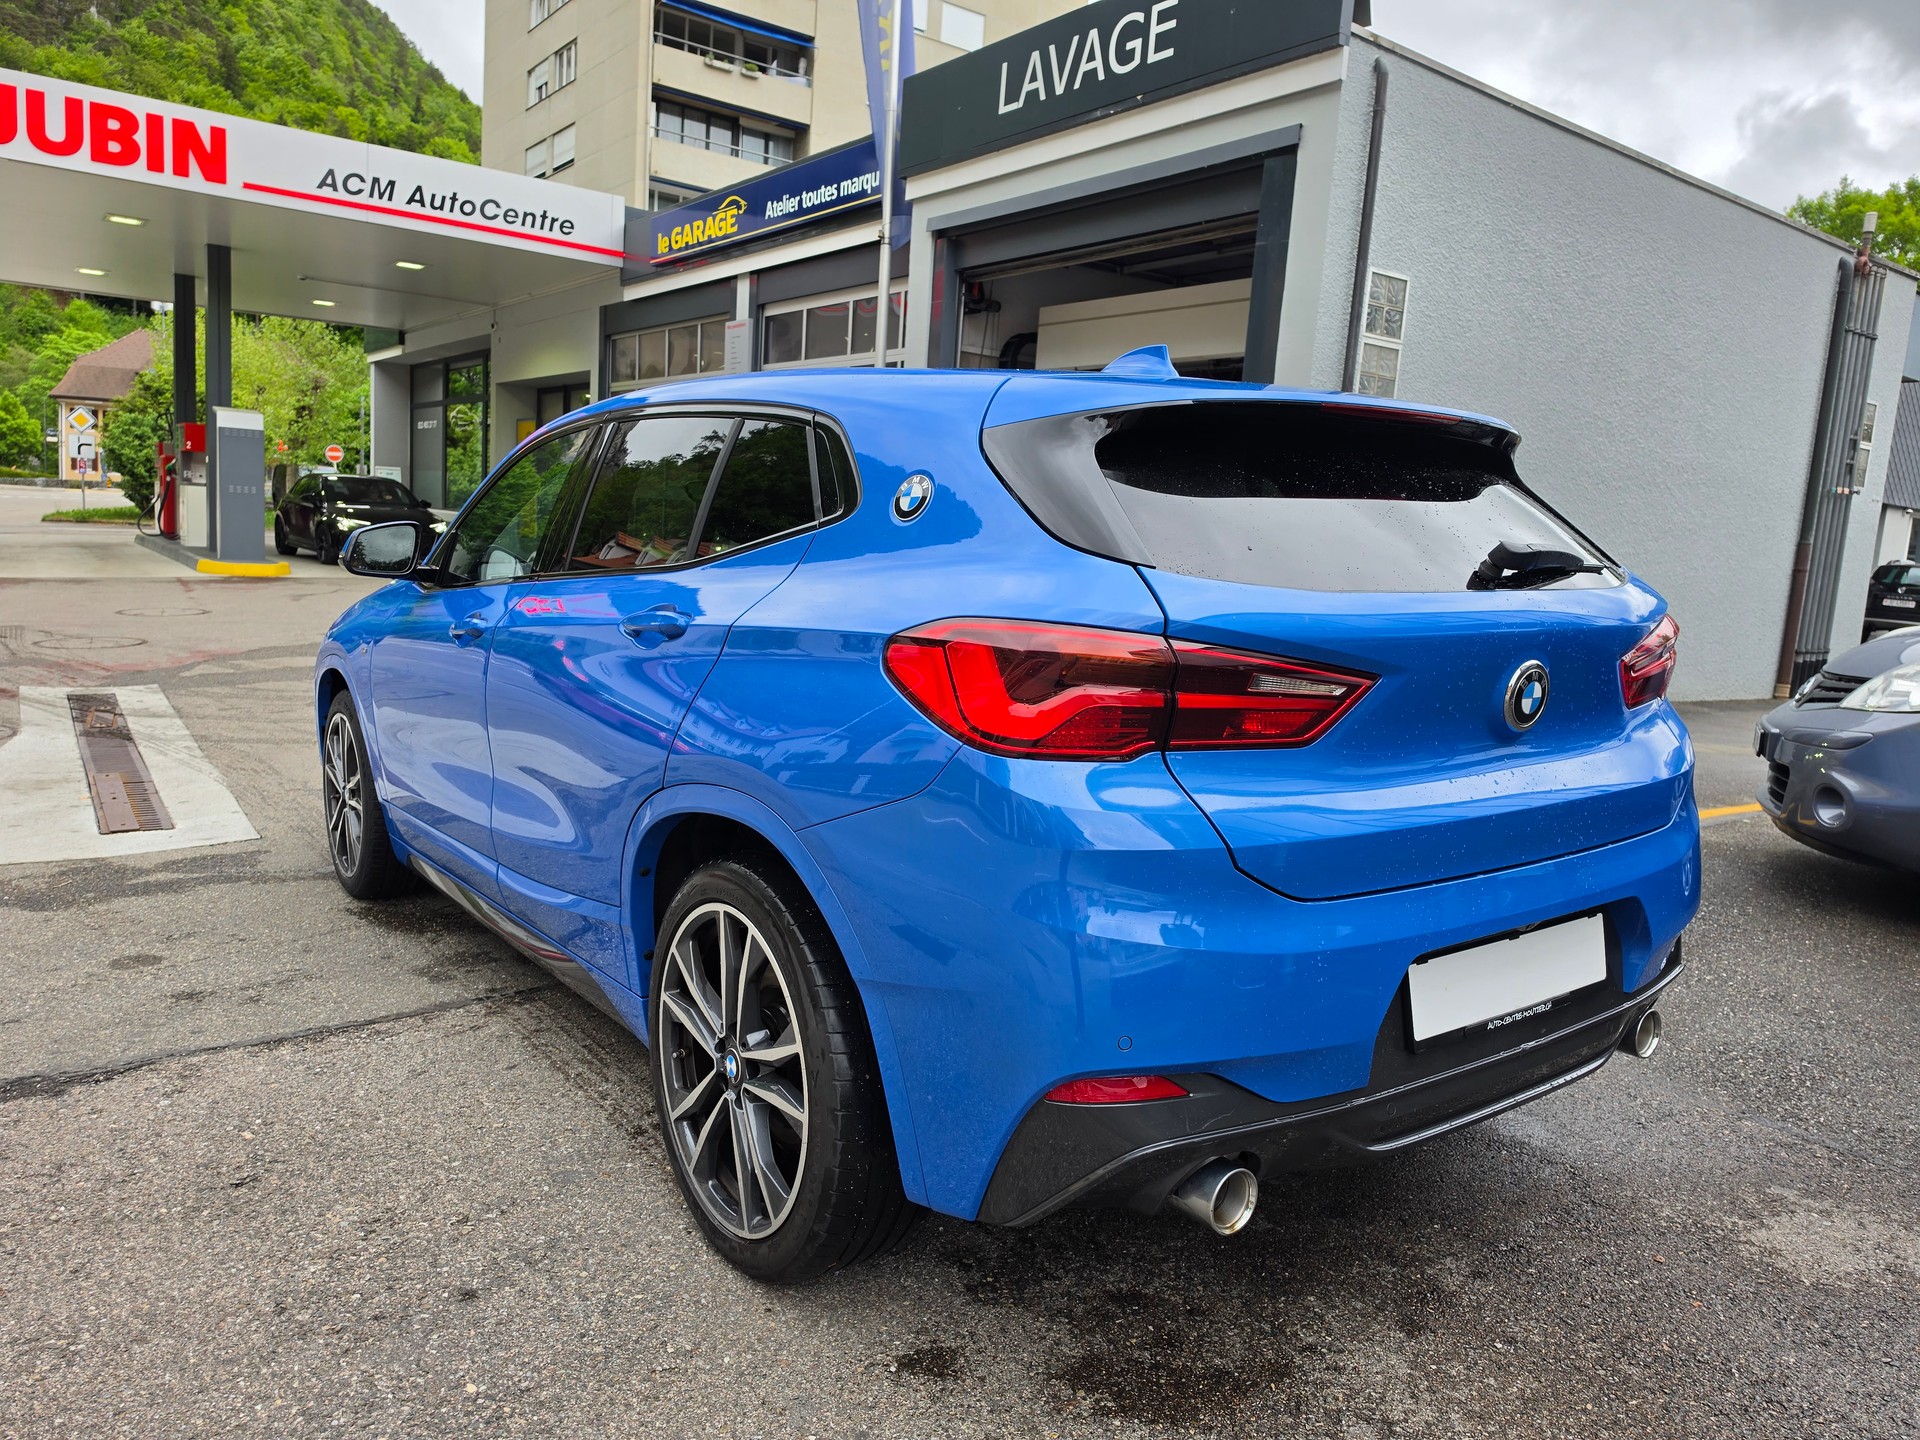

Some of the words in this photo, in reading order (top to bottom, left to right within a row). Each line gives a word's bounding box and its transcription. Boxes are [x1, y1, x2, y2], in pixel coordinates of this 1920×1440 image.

[998, 0, 1179, 115] LAVAGE
[0, 82, 227, 185] JUBIN
[316, 168, 397, 202] ACM
[405, 185, 575, 236] AutoCentre
[764, 195, 800, 220] Atelier
[801, 183, 838, 209] toutes
[840, 170, 880, 197] marqu
[657, 232, 670, 254] le
[671, 208, 738, 250] GARAGE
[186, 441, 192, 449] 2
[1520, 671, 1547, 690] BMW
